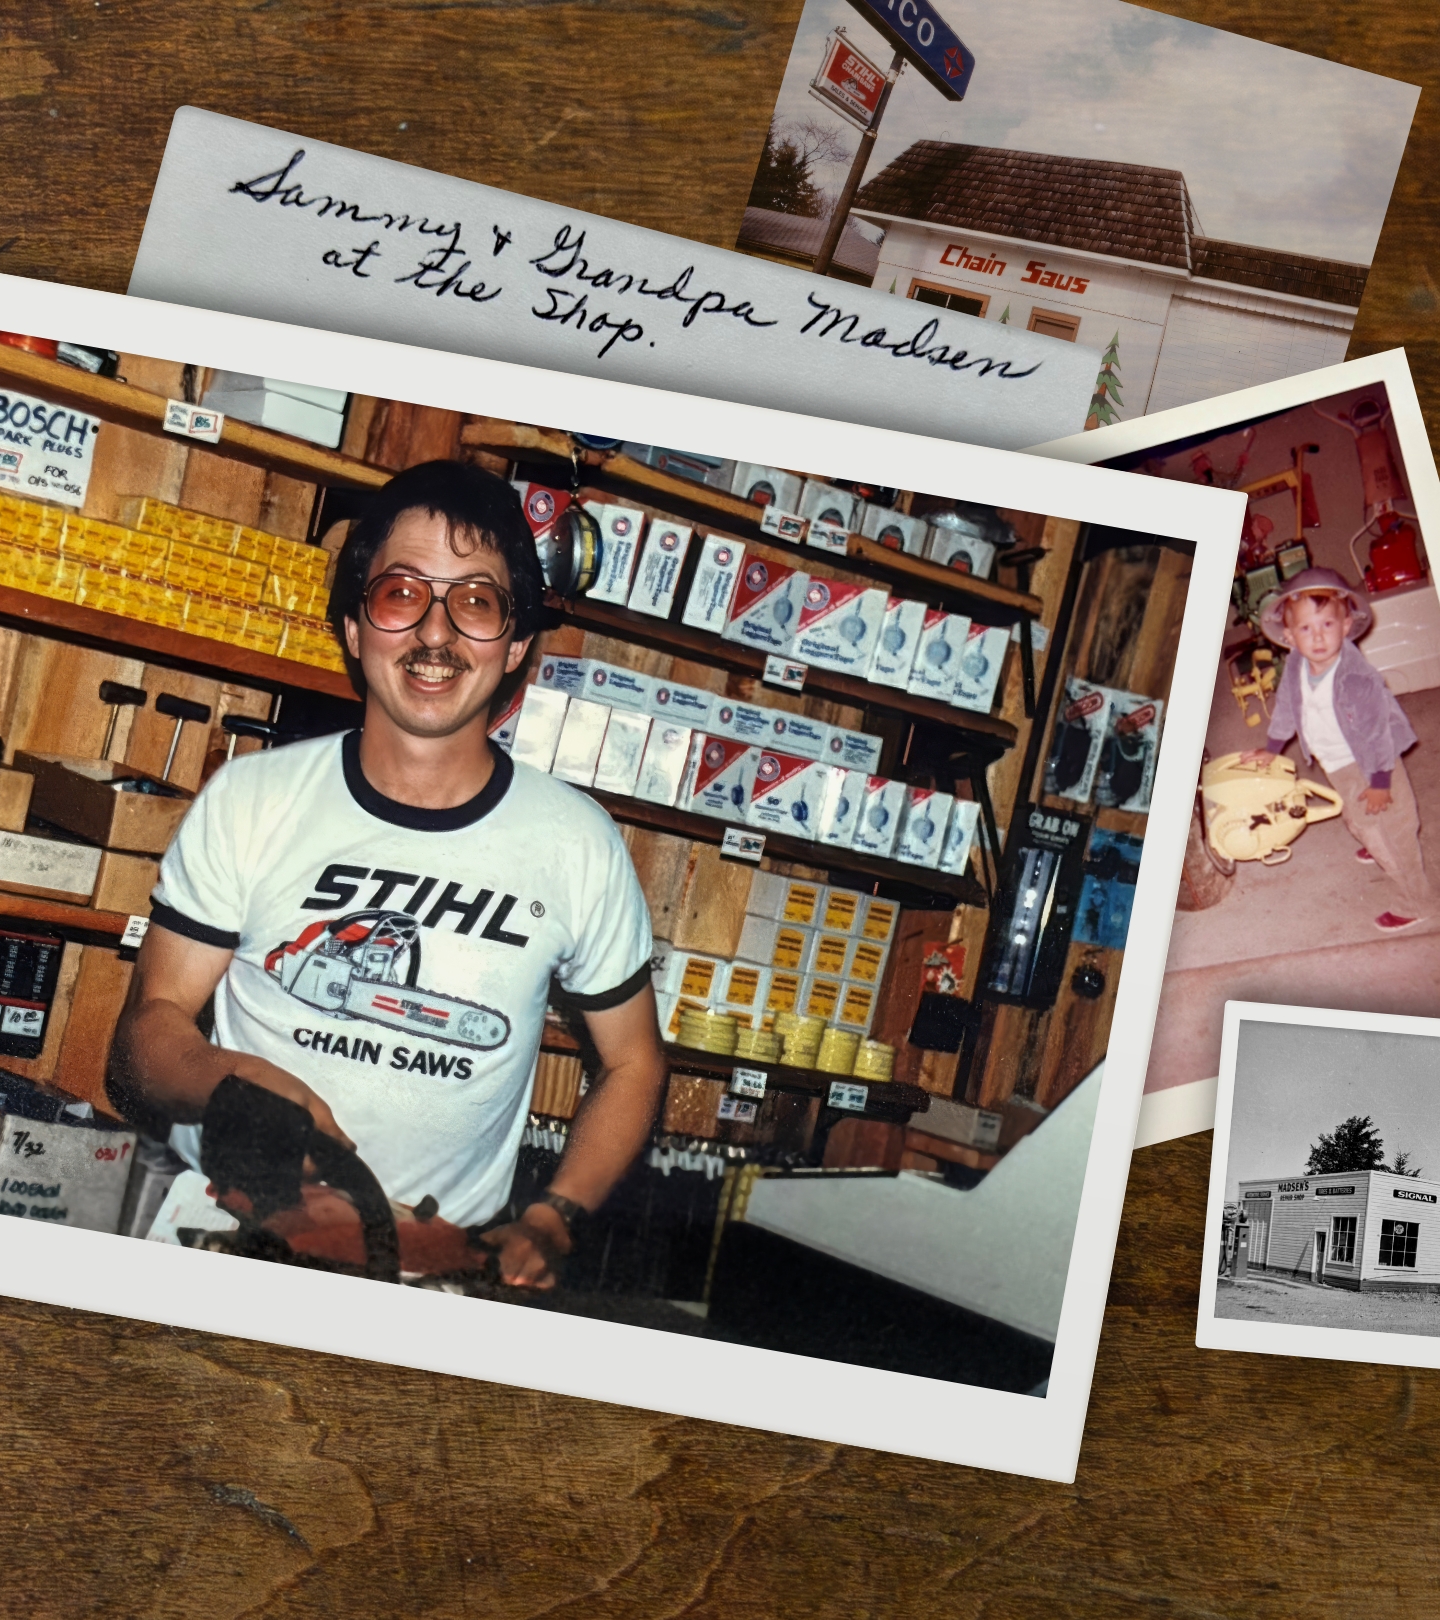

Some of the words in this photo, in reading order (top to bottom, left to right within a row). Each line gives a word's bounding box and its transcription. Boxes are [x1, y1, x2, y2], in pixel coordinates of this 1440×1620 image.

[844, 54, 877, 87] STIHL
[830, 84, 846, 99] SALES
[229, 150, 465, 265] Sammy
[530, 225, 779, 327] Grandpa
[801, 292, 1044, 379] Madsen
[322, 241, 381, 277] at
[394, 250, 503, 301] the
[939, 244, 1007, 277] Chain
[42, 440, 83, 459] PLUGS
[44, 465, 68, 481] FOR
[1029, 811, 1060, 833] GRAB
[1062, 818, 1081, 838] ON
[300, 863, 530, 949] STIHL
[293, 1027, 383, 1066] CHAIN
[389, 1046, 474, 1081] SAWS
[13, 1131, 46, 1158] 7/32
[1277, 1180, 1309, 1192] MADSEN'S
[1292, 1193, 1305, 1201] SHOP
[1397, 1190, 1435, 1203] SIGNAL
